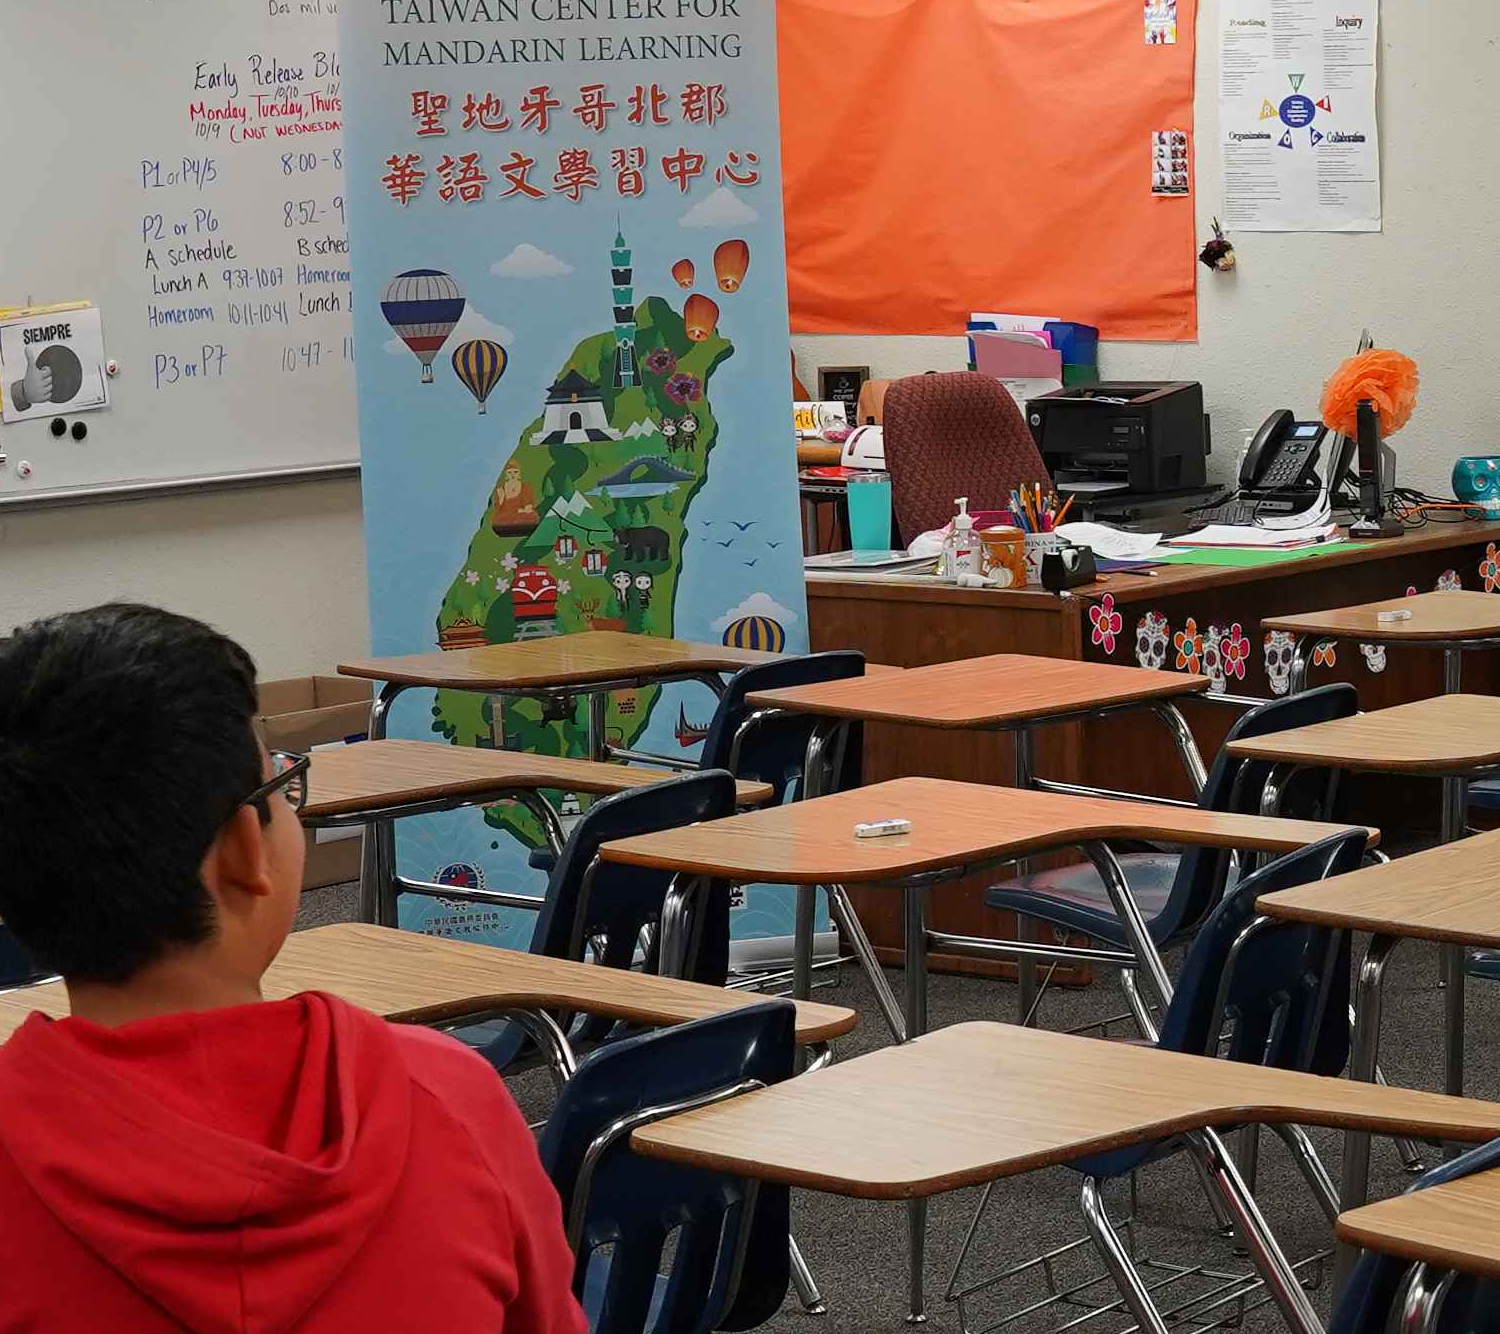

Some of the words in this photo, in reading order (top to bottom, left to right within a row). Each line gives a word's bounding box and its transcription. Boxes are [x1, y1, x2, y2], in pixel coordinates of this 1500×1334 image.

[382, 38, 565, 67] MANDARIN
[579, 35, 741, 62] LEARNING
[195, 61, 238, 98] Early
[248, 54, 304, 85] Release
[410, 83, 729, 137] 聖地牙哥北郡
[196, 123, 220, 140] 10/9
[275, 121, 342, 138] WEDNESDA
[182, 156, 217, 190] P4/5
[381, 146, 762, 205] 華語文學習中心
[142, 214, 165, 242] P2
[174, 223, 187, 235] or
[194, 208, 218, 232] P6
[145, 251, 158, 270] A
[168, 240, 237, 267] schedule
[298, 238, 311, 257] B
[153, 274, 192, 295] Lunch
[198, 273, 208, 290] A
[148, 305, 215, 327] Homeroom
[299, 292, 340, 316] Lunch
[22, 323, 72, 346] SIEMPRE
[156, 354, 180, 389] P3
[202, 344, 227, 377] P7
